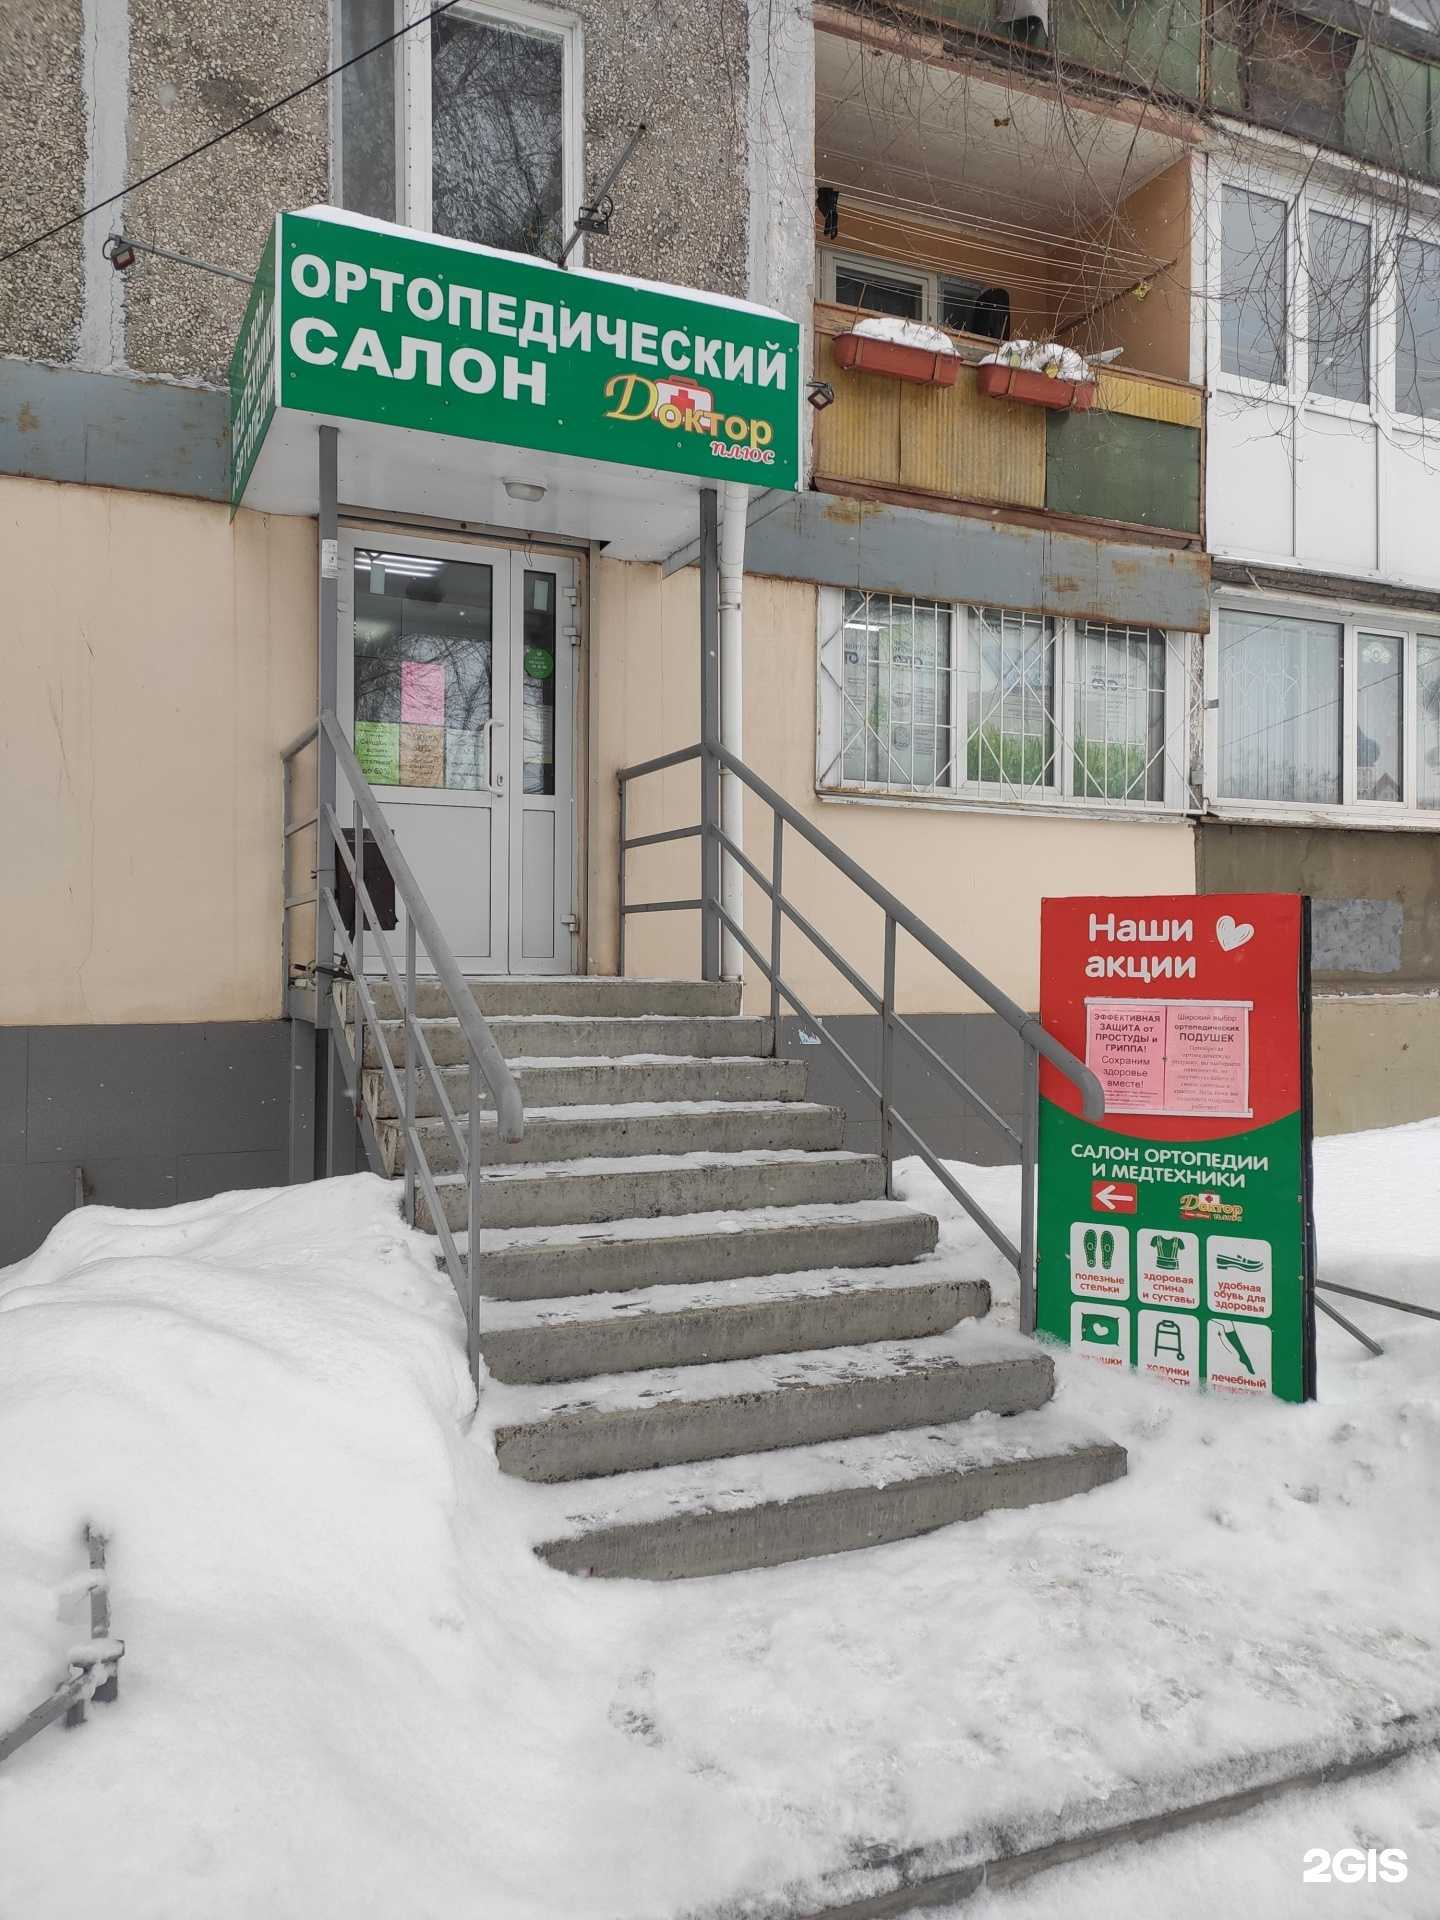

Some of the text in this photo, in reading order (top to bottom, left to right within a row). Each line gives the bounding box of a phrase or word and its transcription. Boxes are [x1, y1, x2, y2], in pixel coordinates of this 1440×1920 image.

[290, 254, 788, 391] ОРТОПЕДИЧЕСКИЙ
[289, 316, 547, 406] САЛОН
[603, 373, 774, 450] Доктор
[709, 440, 777, 465] плюс
[1088, 913, 1194, 942] Наши
[1084, 955, 1197, 983] акции
[1094, 1013, 1161, 1022] ЭФФЕКТИВНАЯ
[1100, 1023, 1141, 1032] ЗАЩИТА
[1095, 1033, 1150, 1043] ПРОСТУДЫ
[1179, 1032, 1235, 1043] ПОДУШЕК
[1105, 1043, 1147, 1053] ГРИППА!
[1101, 1055, 1150, 1066] Сохраним
[1103, 1068, 1148, 1077] здоровье
[1107, 1080, 1144, 1089] вместе!
[1071, 1143, 1270, 1172] САЛОН ОРТОПЕДИИ
[1092, 1162, 1246, 1189] И МЕДТЕХНИКИ
[1075, 1272, 1125, 1285] полезные
[1143, 1273, 1195, 1286] здоровая
[1079, 1282, 1121, 1295] стельки
[1152, 1283, 1185, 1294] спина
[1217, 1280, 1263, 1294] удобная
[1151, 1293, 1196, 1305] суставы
[1213, 1289, 1266, 1305] обувь для
[1215, 1301, 1265, 1314] здоровья
[1211, 1373, 1267, 1389] лечебный
